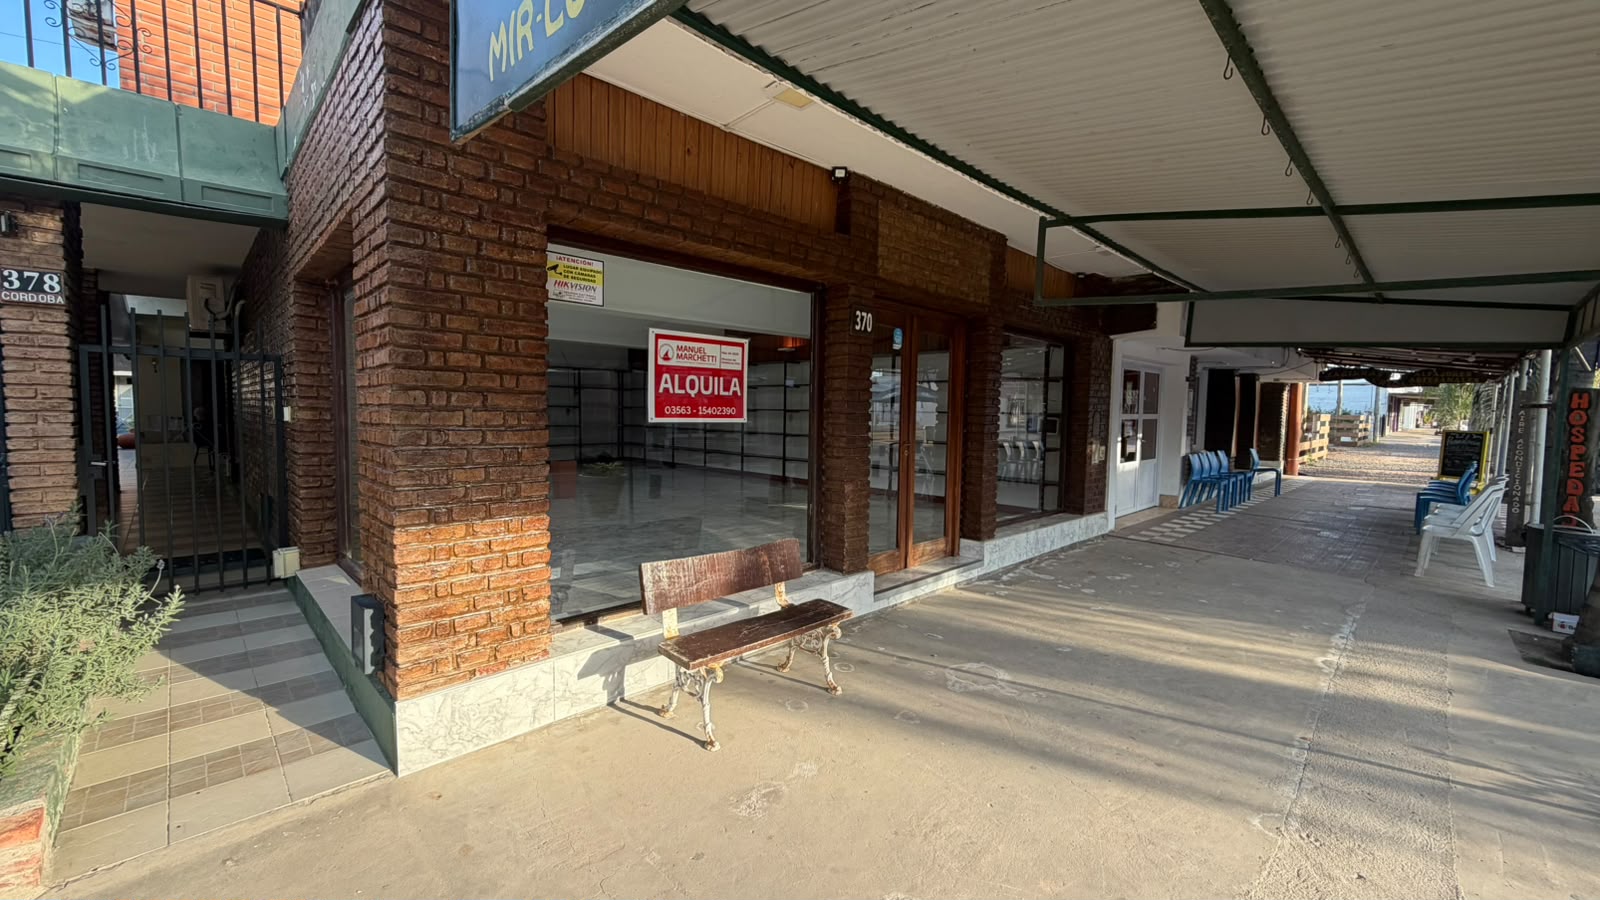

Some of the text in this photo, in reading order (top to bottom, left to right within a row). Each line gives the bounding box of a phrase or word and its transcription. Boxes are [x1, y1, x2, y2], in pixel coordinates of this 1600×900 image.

[2, 269, 61, 293] 378
[554, 280, 597, 292] HIKVISION
[1, 291, 64, 304] CORDOBA
[855, 310, 873, 332] 370
[676, 345, 707, 354] MANUEL
[676, 353, 717, 363] MARCHETTI
[658, 373, 742, 398] ALQUILA
[664, 405, 692, 415] 03563
[698, 405, 736, 415] 15402390
[1512, 439, 1524, 513] ACONDICIONADO
